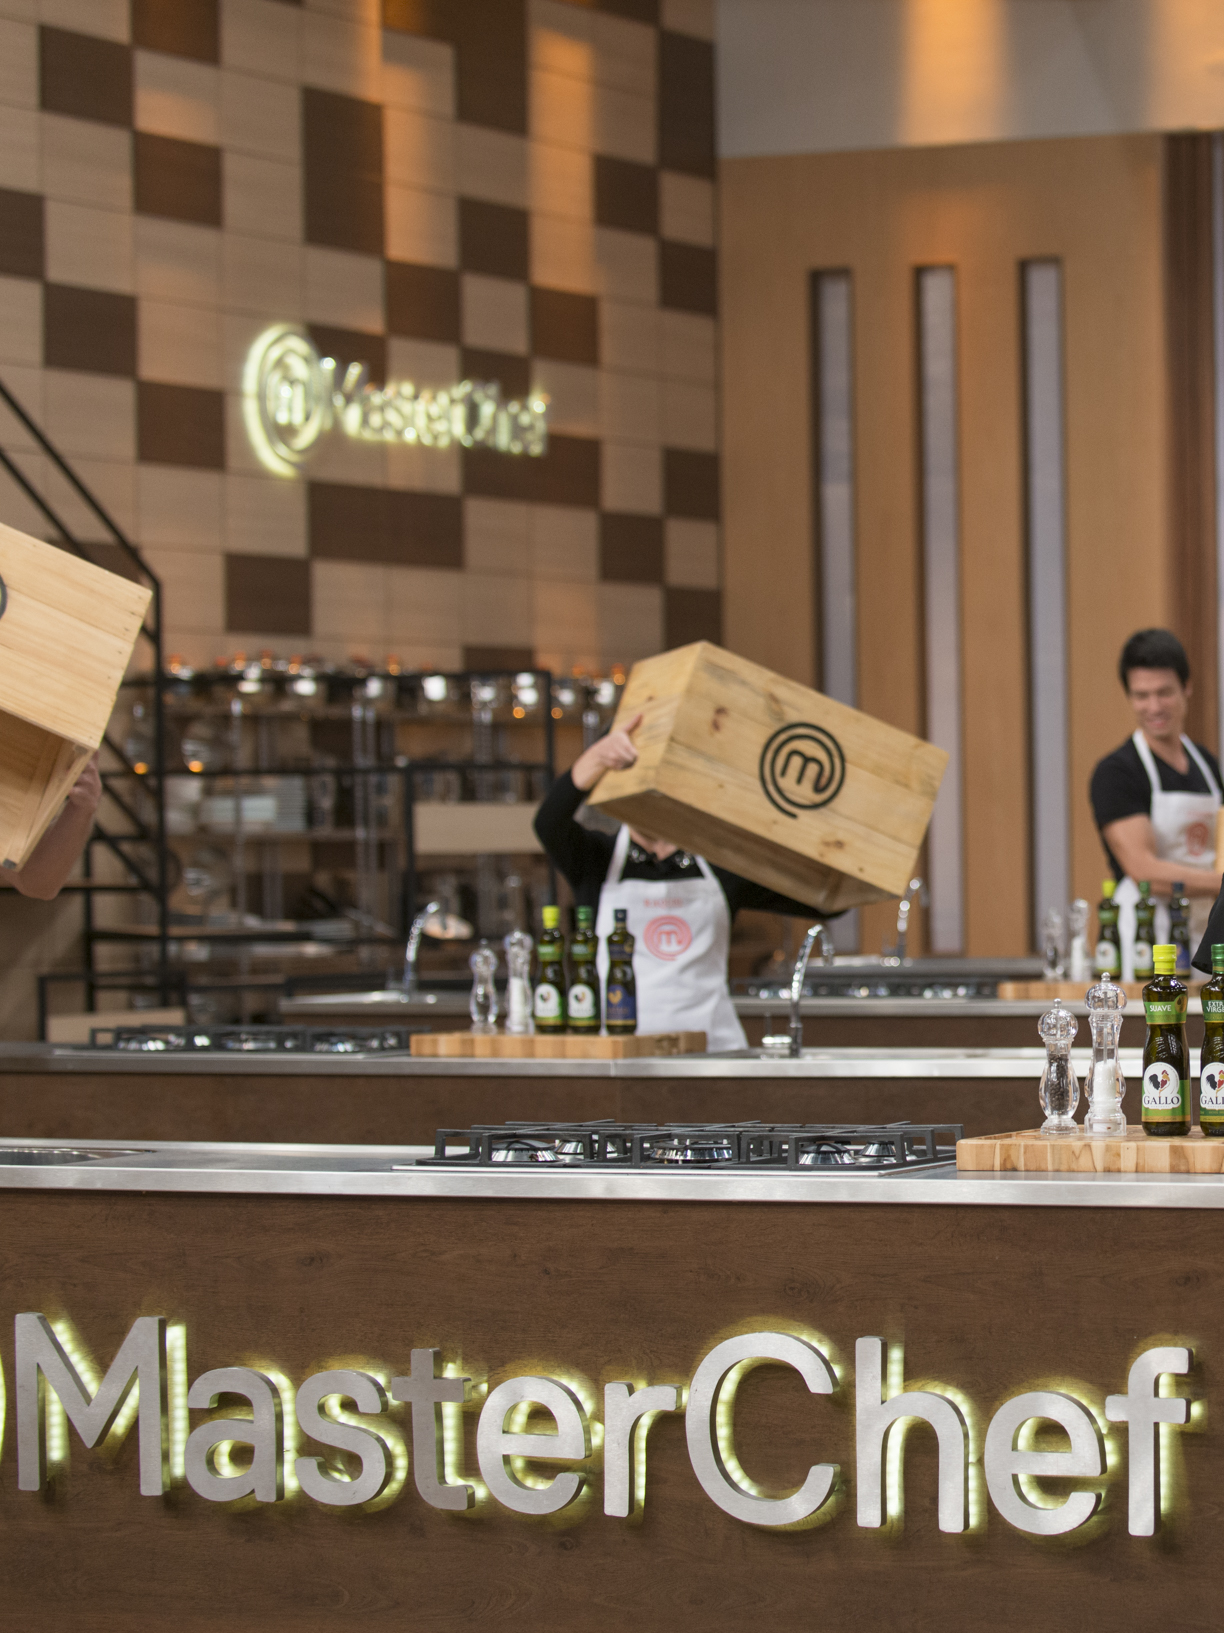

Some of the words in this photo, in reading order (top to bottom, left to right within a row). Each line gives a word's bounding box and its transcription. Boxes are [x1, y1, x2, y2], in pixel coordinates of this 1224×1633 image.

[1149, 1004, 1172, 1012] SUAVE
[1143, 1095, 1180, 1105] GALLO
[14, 1311, 1196, 1539] MasterChef
